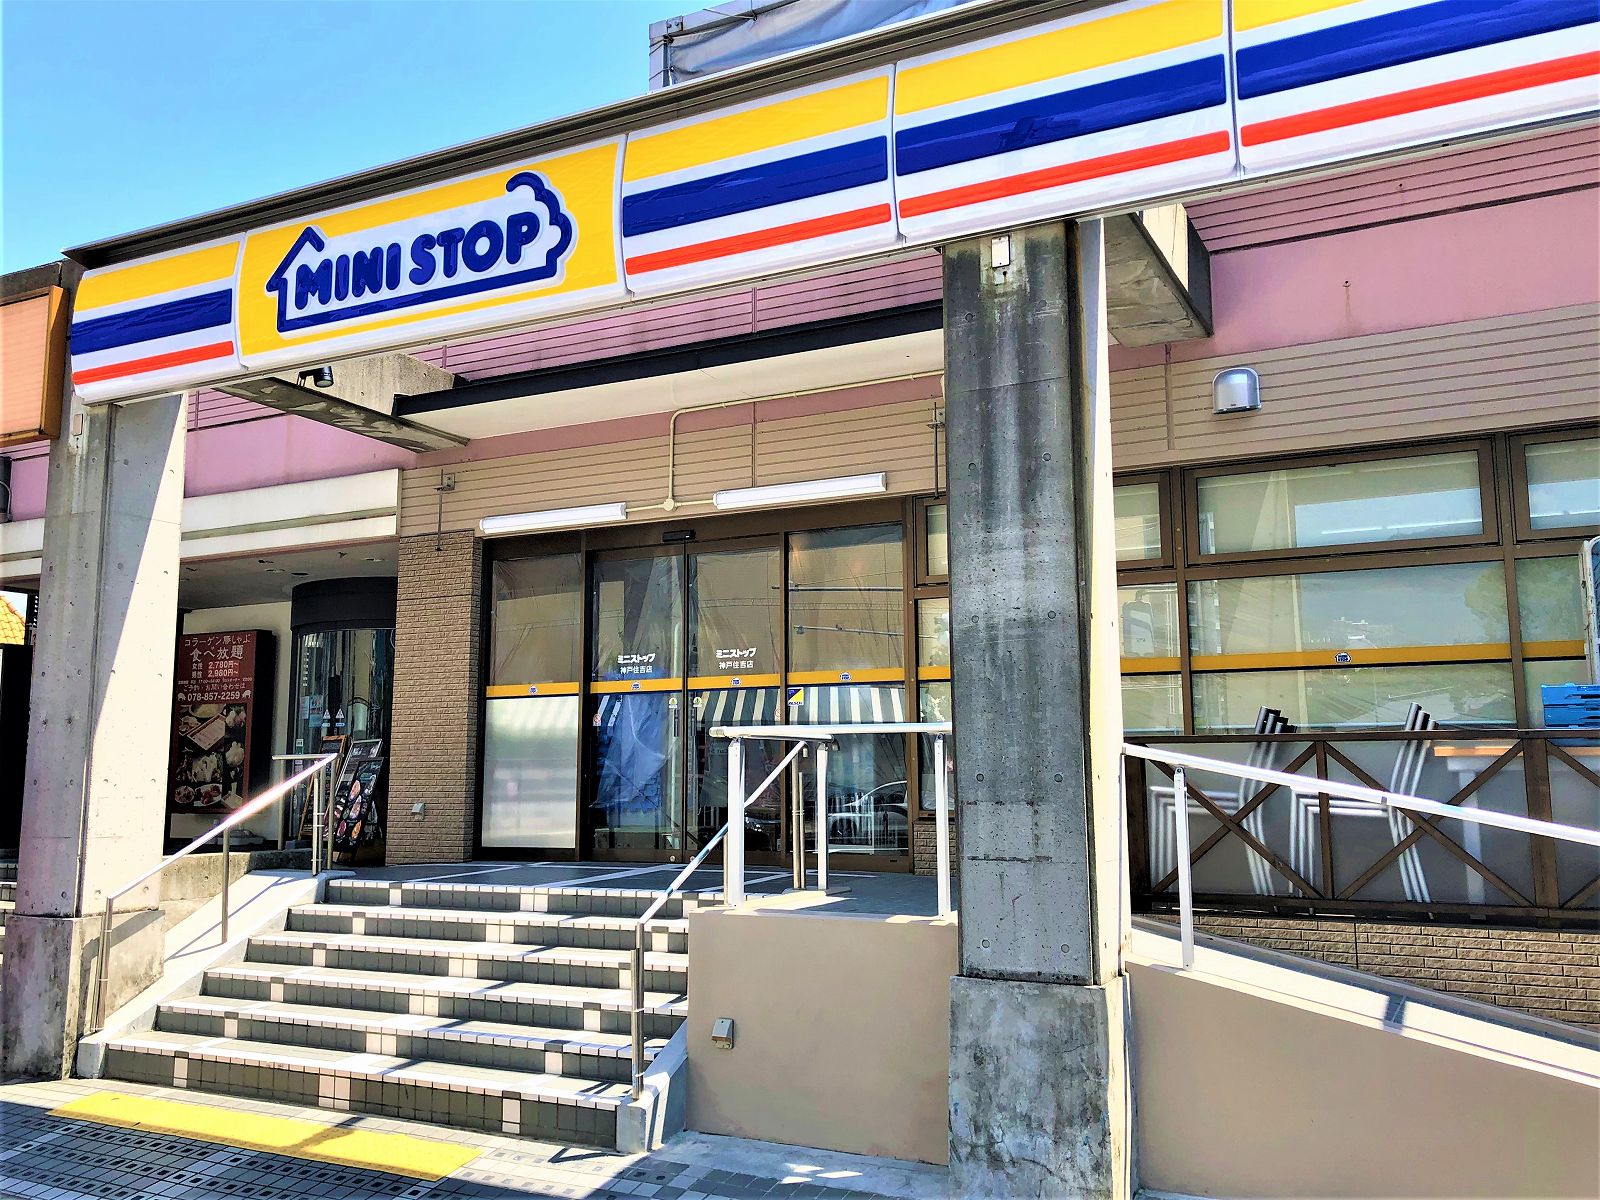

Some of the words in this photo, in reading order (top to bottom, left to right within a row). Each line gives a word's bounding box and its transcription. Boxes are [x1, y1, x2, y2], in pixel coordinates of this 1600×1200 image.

[295, 242, 401, 310] MINI
[408, 211, 540, 286] STOP
[190, 644, 244, 662] 食べ放題
[617, 652, 656, 664] ミニストップ
[716, 647, 757, 659] ミニストップ
[619, 665, 653, 675] 神戸住吉店
[718, 660, 754, 670] 神戸住吉店
[187, 691, 241, 702] 078-857-2259
